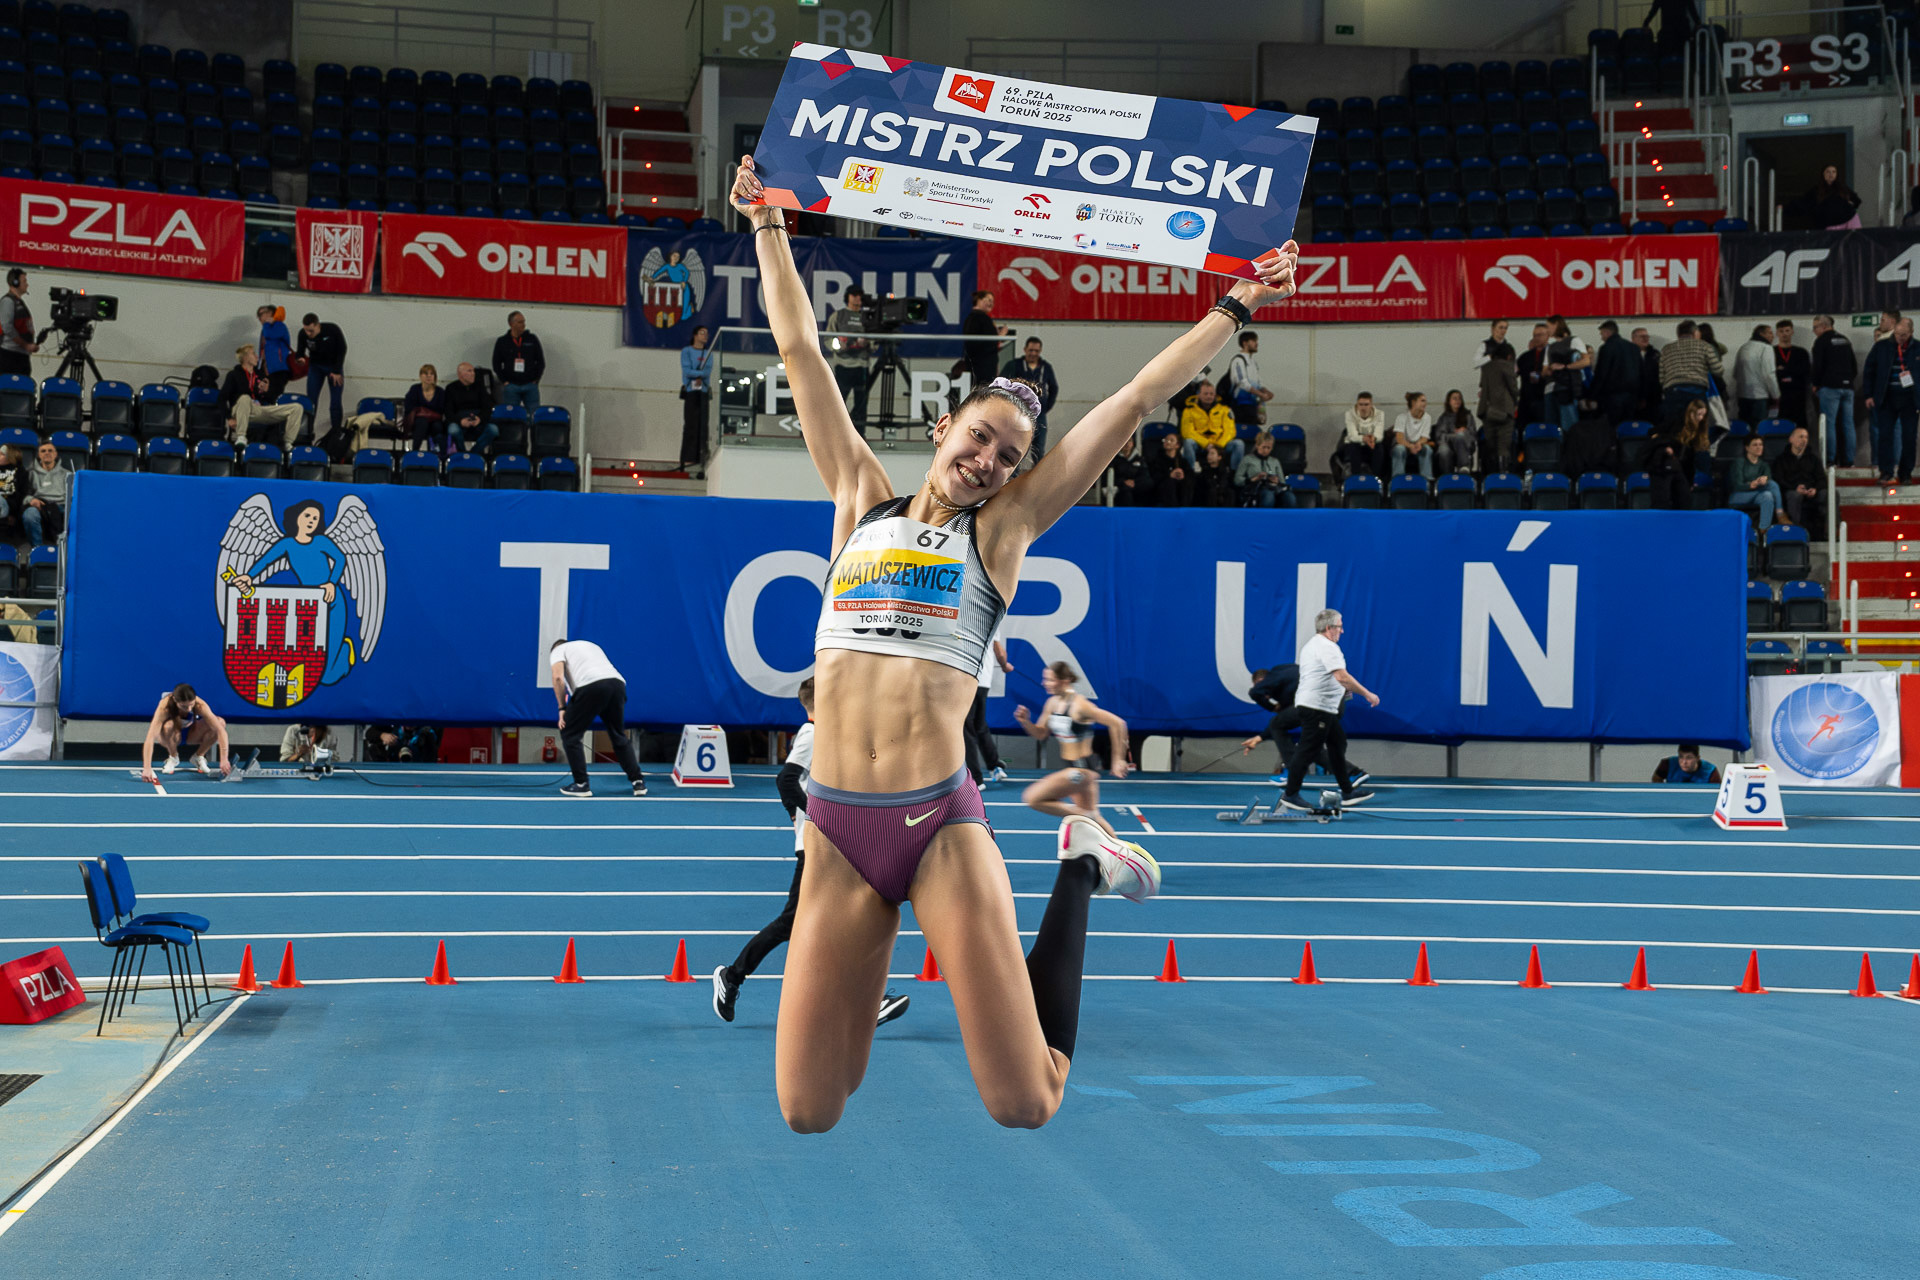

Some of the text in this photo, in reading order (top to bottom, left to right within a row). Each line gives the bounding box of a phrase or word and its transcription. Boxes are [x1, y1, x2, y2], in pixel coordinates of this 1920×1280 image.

[722, 5, 873, 48] P3 R3
[1722, 32, 1870, 78] R3 S3
[1005, 86, 1054, 101] 69. PZLA
[999, 104, 1073, 123] TORUŃ 2025
[1002, 95, 1142, 120] HALOWE MISTRZOSTWA POLSKI
[789, 98, 1274, 207] MISTRZ POLSKI
[929, 188, 954, 199] Sportu
[960, 193, 994, 205] Turystyki
[931, 181, 980, 195] Ministerstwo
[19, 193, 206, 251] PZLA
[872, 207, 893, 216] 4F
[1014, 209, 1051, 220] ORLEN
[1098, 212, 1144, 226] TORUŃ
[1102, 208, 1136, 217] MIASTO
[19, 240, 207, 266] POLSKI ZWIĄZEK LEKKIEJ ATLETYKI
[477, 242, 607, 278] ORLEN
[313, 259, 360, 277] PZLA
[1071, 264, 1197, 295] ORLEN
[1297, 254, 1427, 294] ZLA
[1561, 258, 1698, 290] ORLEN
[1740, 248, 1830, 295] 4F
[1381, 297, 1428, 306] ATLETYKI
[916, 529, 950, 550] 67
[837, 561, 961, 593] MATUSZEWICZ
[859, 612, 923, 627] TORUŃ 2025
[887, 600, 931, 614] Mistrzostwa
[931, 608, 954, 617] Polski
[696, 742, 716, 772] 6
[1744, 782, 1767, 814] 5
[19, 966, 75, 1007] PZLA
